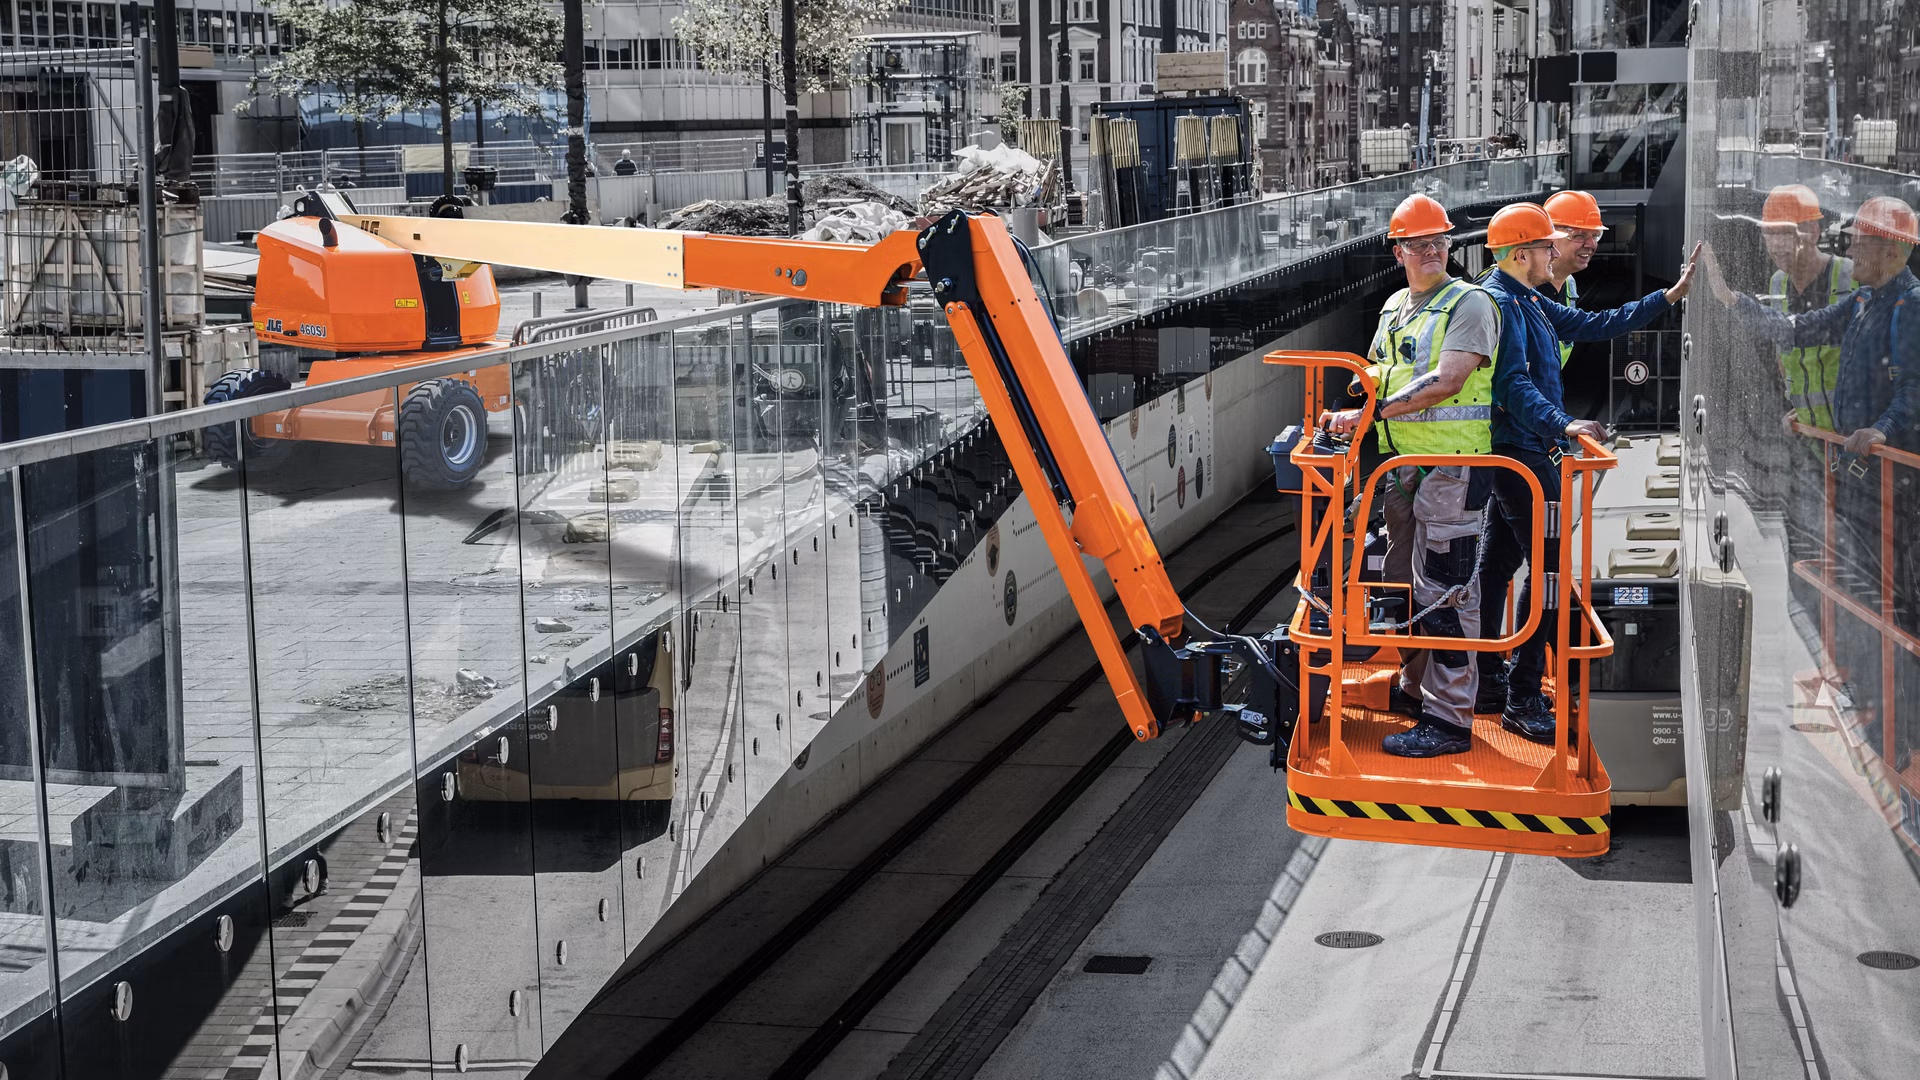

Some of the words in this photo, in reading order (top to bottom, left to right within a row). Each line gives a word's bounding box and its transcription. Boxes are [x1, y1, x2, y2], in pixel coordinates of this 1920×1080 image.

[266, 318, 283, 333] JLG
[300, 322, 327, 338] 460SJ
[1618, 587, 1644, 603] 28
[1652, 727, 1672, 735] 0900
[1652, 736, 1677, 745] Qbuzz
